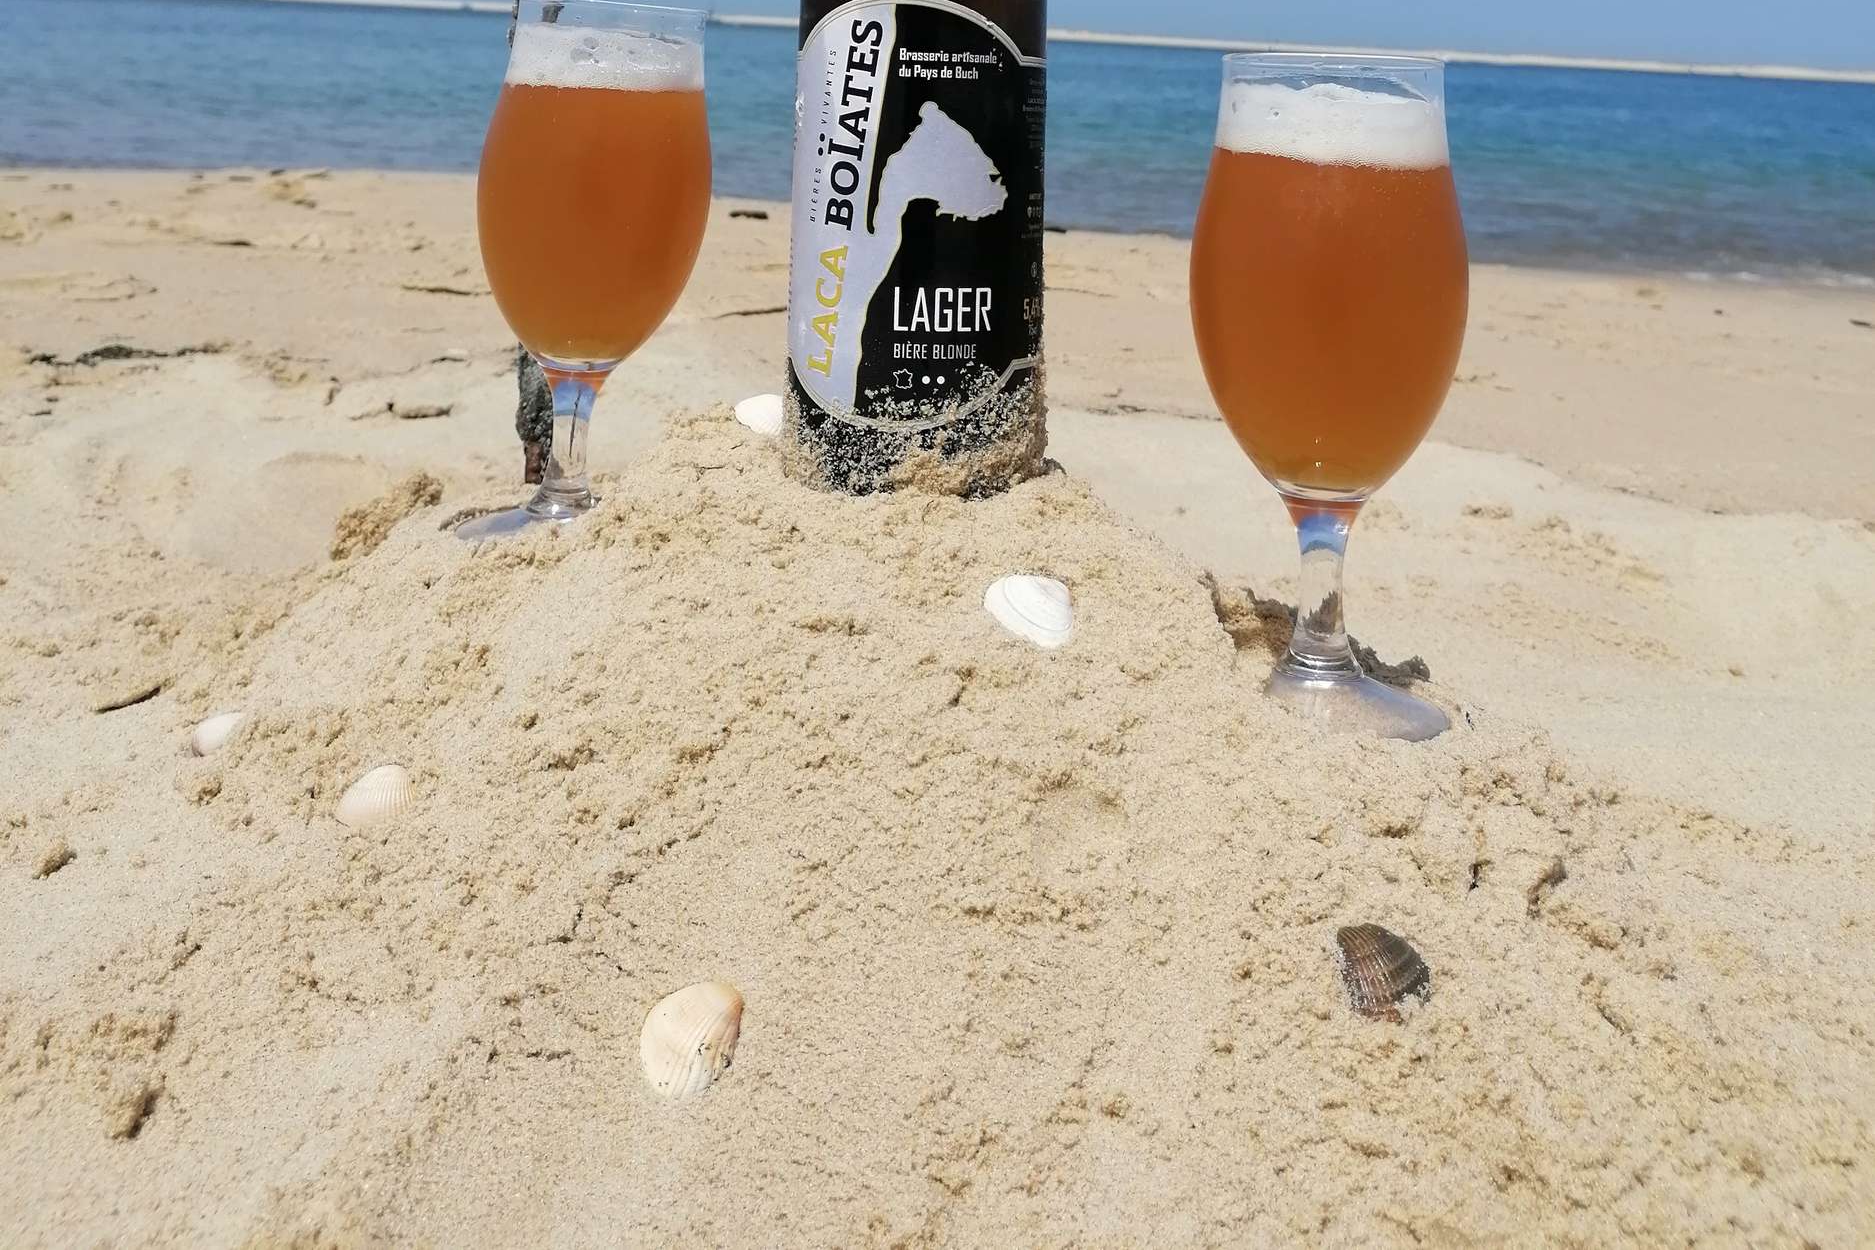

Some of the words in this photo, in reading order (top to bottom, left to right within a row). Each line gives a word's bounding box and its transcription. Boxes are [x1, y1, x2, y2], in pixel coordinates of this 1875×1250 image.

[898, 64, 911, 77] du
[913, 65, 938, 80] Pays
[941, 65, 953, 78] de
[955, 66, 979, 79] Buch
[899, 48, 949, 62] Brasserie
[951, 51, 997, 64] artisanale
[820, 49, 837, 125] VIVANTES
[807, 244, 849, 378] LACA
[893, 286, 992, 332] LAGER
[893, 340, 927, 359] BIÈRE
[933, 343, 977, 360] BLONDE
